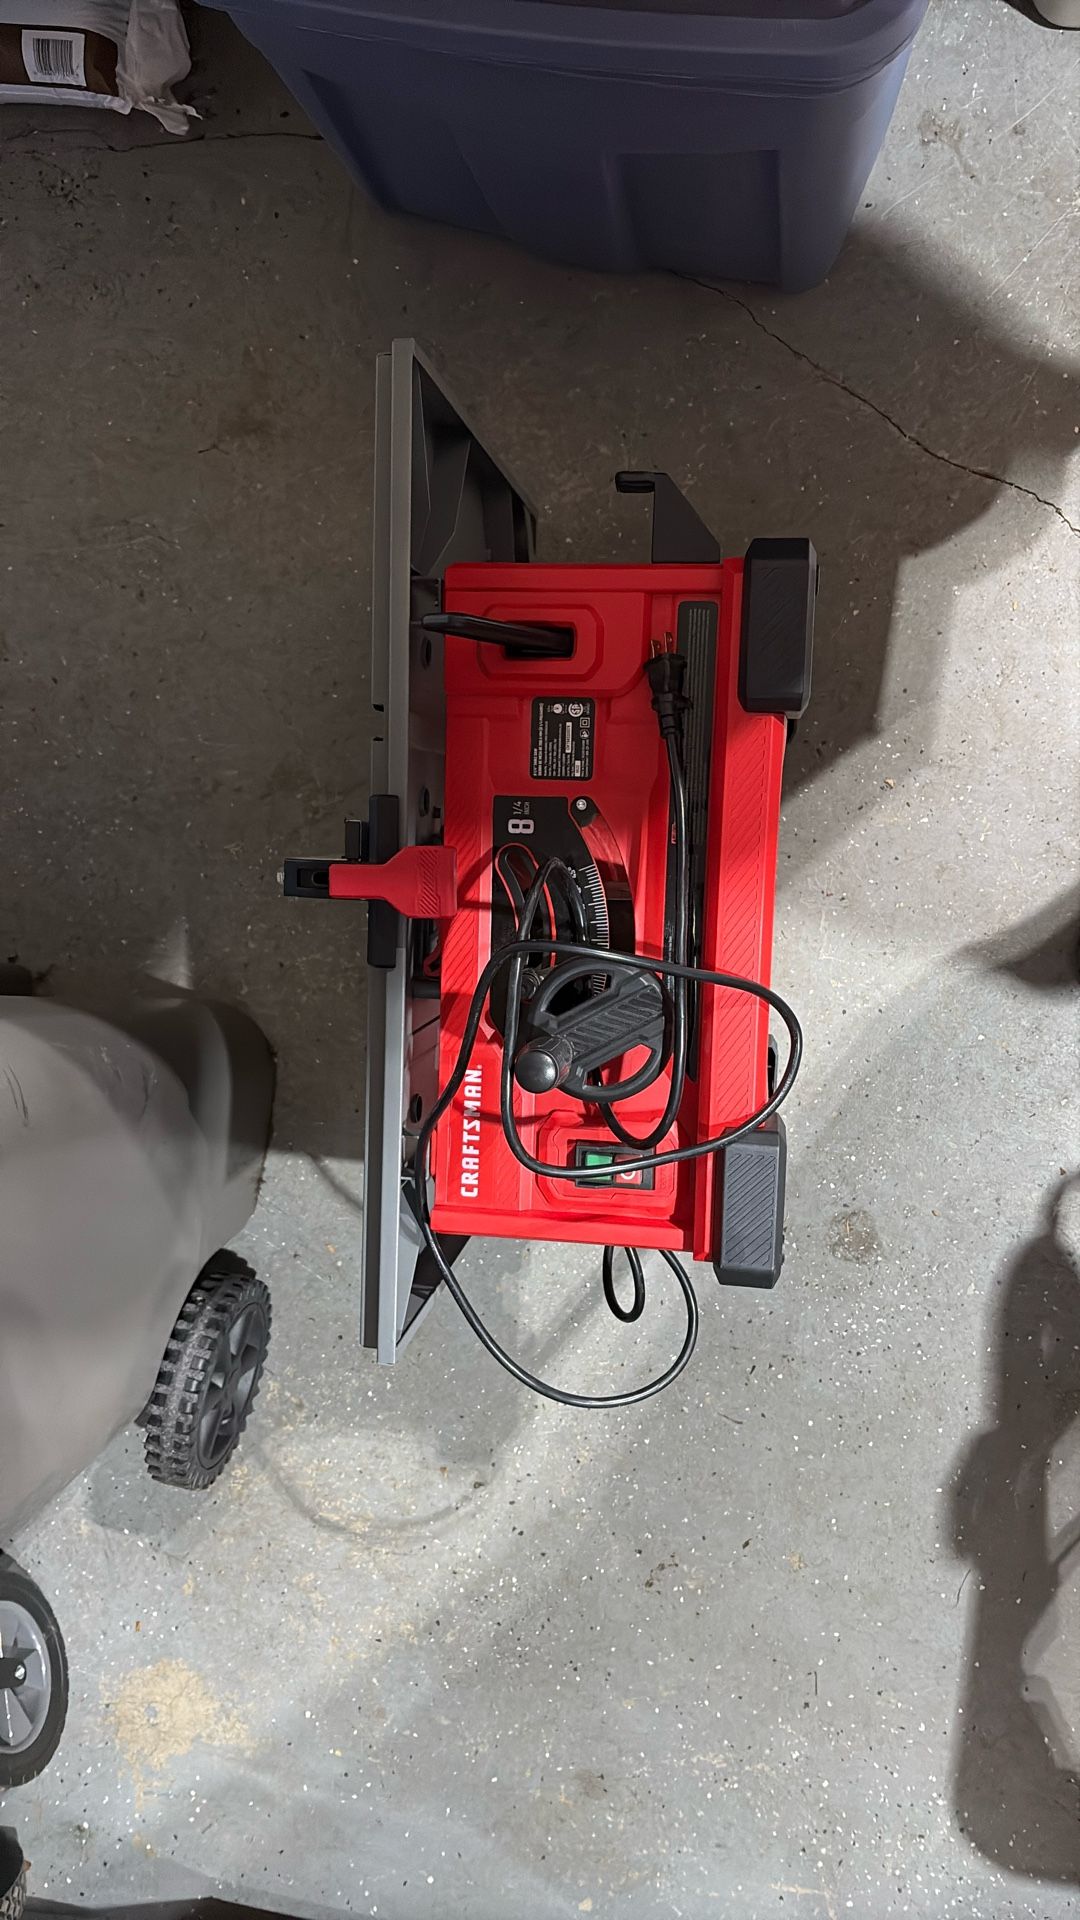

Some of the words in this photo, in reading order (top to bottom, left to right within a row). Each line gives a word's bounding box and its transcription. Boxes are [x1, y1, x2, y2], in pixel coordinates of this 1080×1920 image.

[513, 801, 523, 815] 1/4
[508, 819, 534, 834] 8
[460, 1068, 482, 1198] CRAFTSMAN
